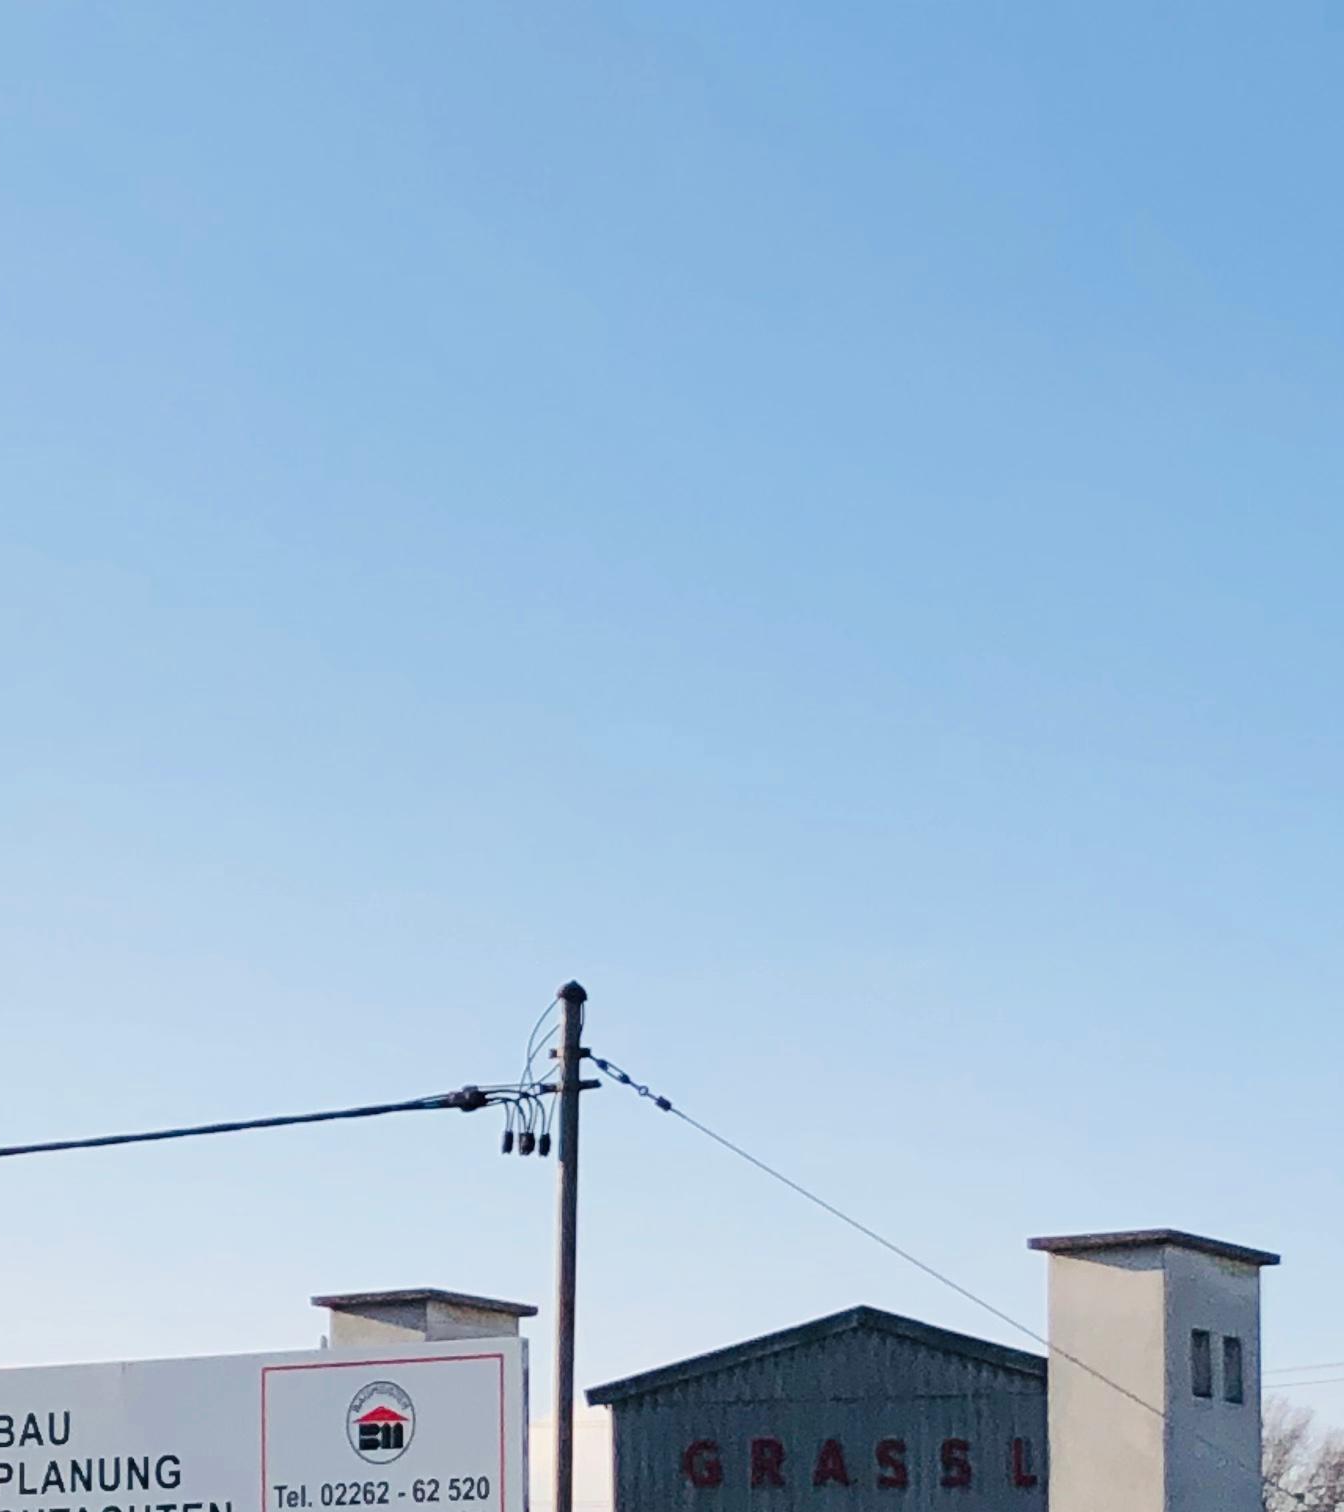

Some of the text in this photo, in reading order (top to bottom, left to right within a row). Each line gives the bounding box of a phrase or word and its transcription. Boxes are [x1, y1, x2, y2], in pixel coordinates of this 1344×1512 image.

[683, 1438, 1038, 1488] GRASSL
[273, 1485, 312, 1508] Tel.
[321, 1481, 389, 1506] 02262
[412, 1479, 440, 1502] 62
[448, 1476, 490, 1500] 520
